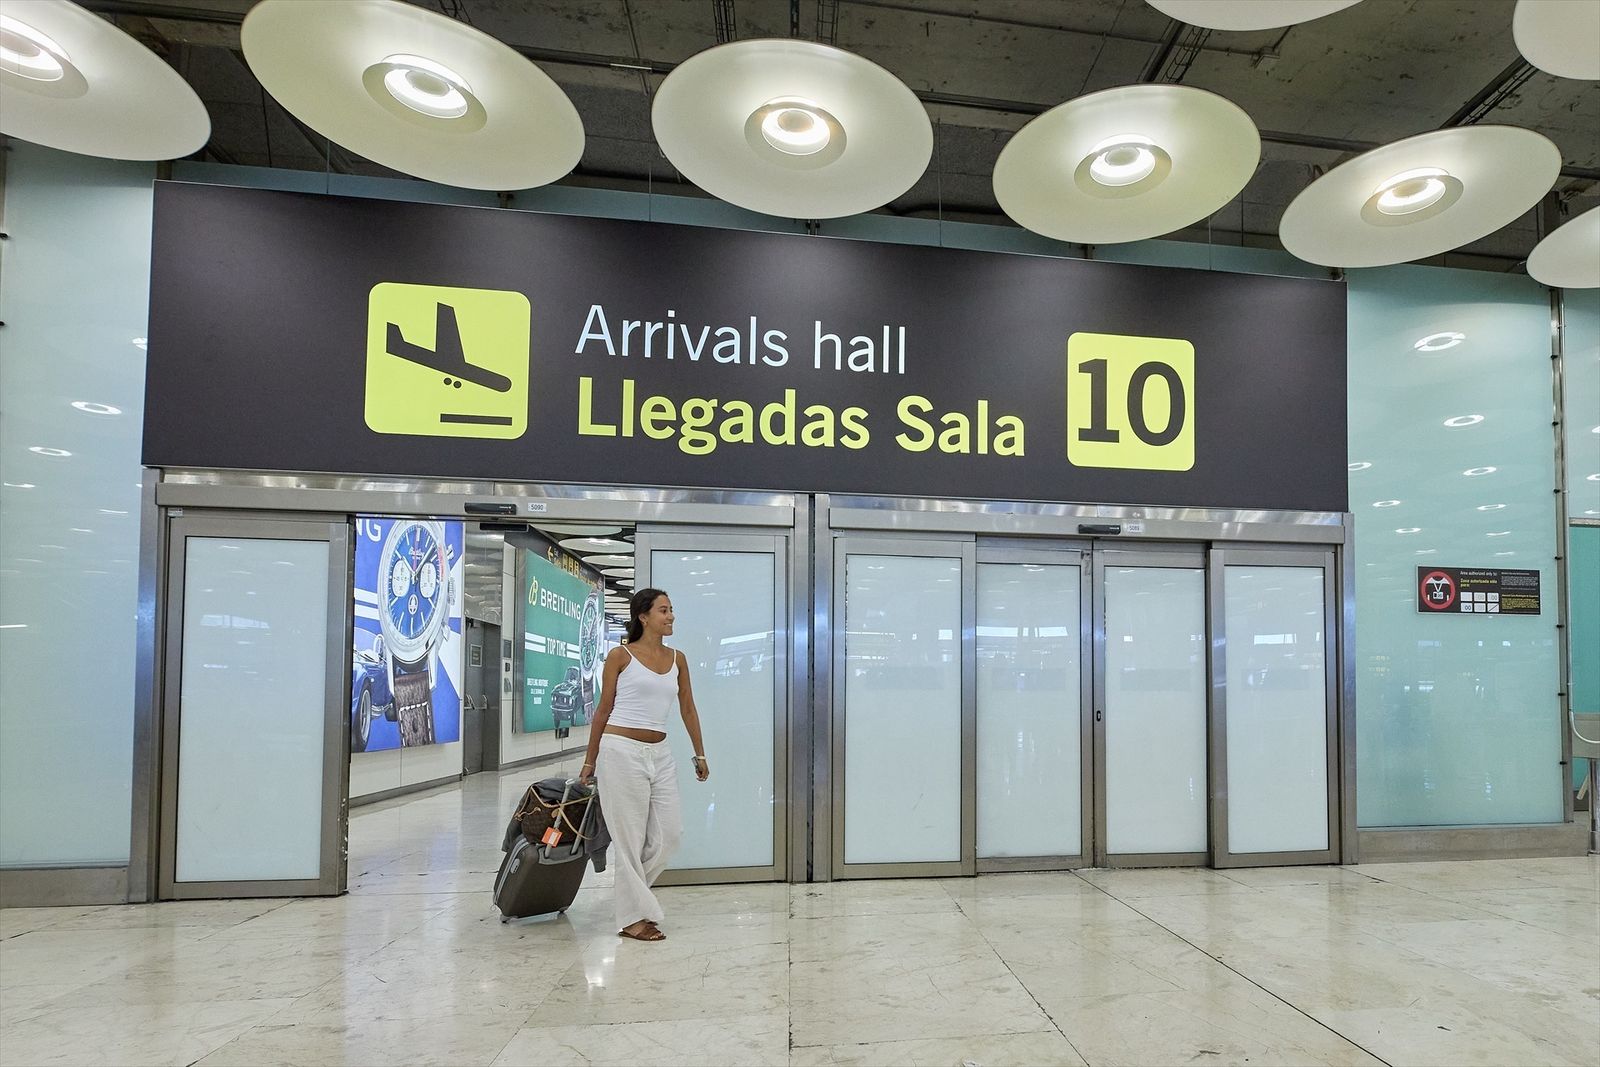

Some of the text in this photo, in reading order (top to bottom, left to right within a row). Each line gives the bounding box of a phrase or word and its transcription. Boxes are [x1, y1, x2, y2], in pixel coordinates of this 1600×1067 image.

[574, 304, 906, 375] Arrivals hall
[578, 376, 1026, 457] Llegadas Sala
[1077, 357, 1187, 447] 10
[540, 587, 581, 621] BREITLING
[546, 637, 556, 655] TOP
